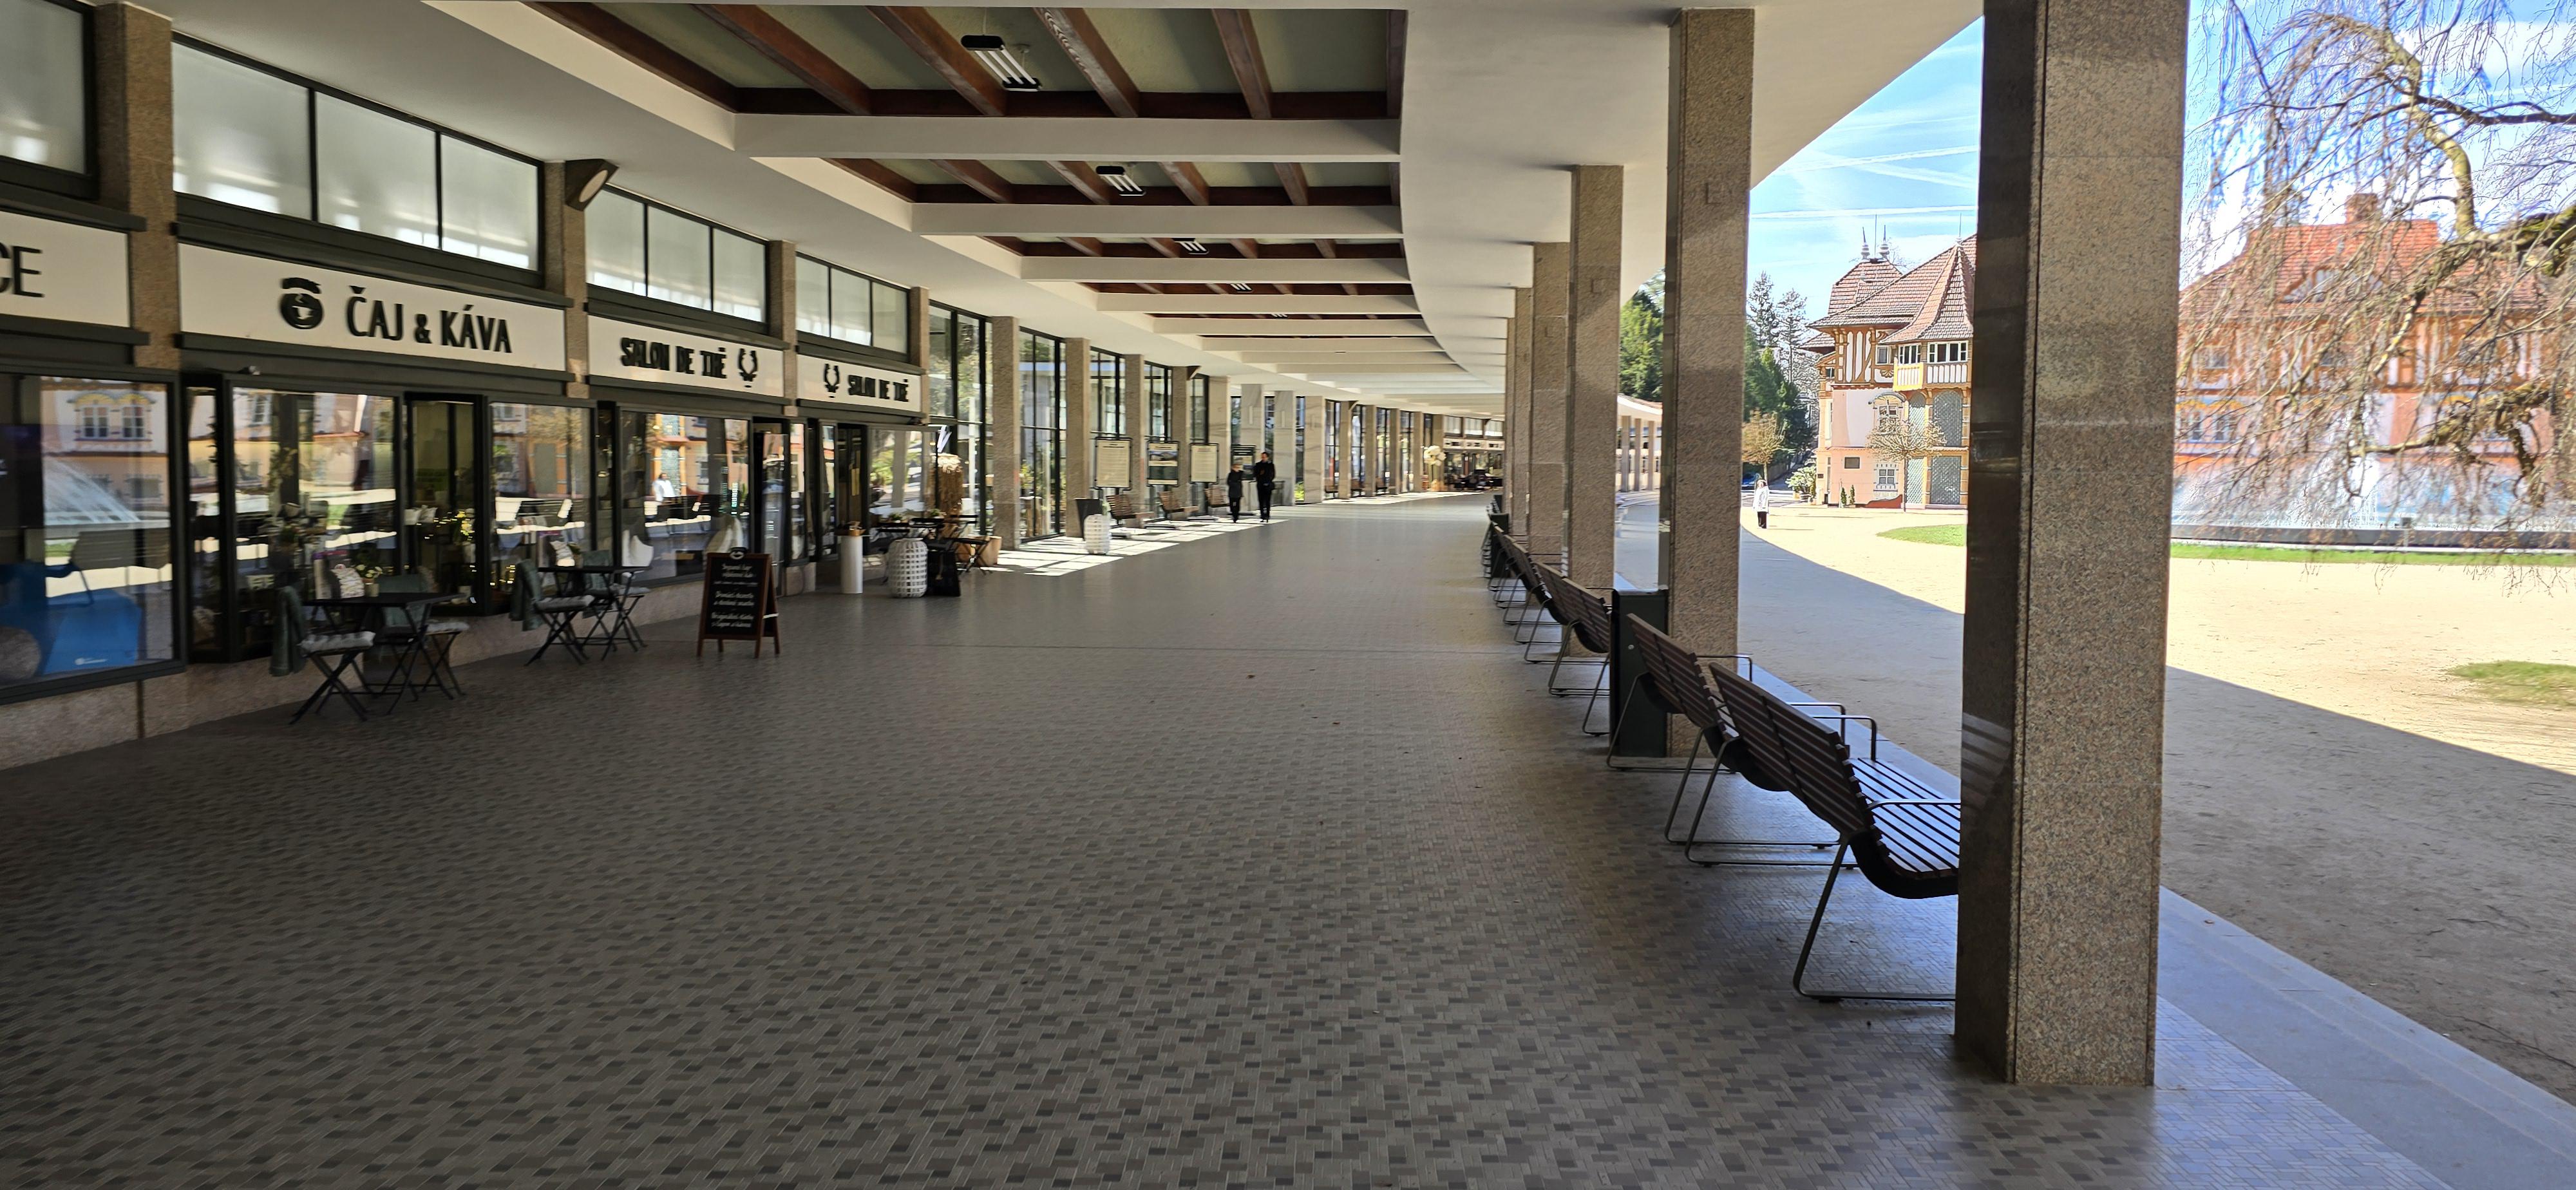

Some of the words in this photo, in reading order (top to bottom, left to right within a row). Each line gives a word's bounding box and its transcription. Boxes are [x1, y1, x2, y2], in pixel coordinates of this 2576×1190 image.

[346, 285, 404, 341] ČAJ
[415, 313, 433, 345] &
[439, 304, 513, 354] KÁVA
[620, 337, 670, 372] SALON
[676, 346, 696, 375] DE
